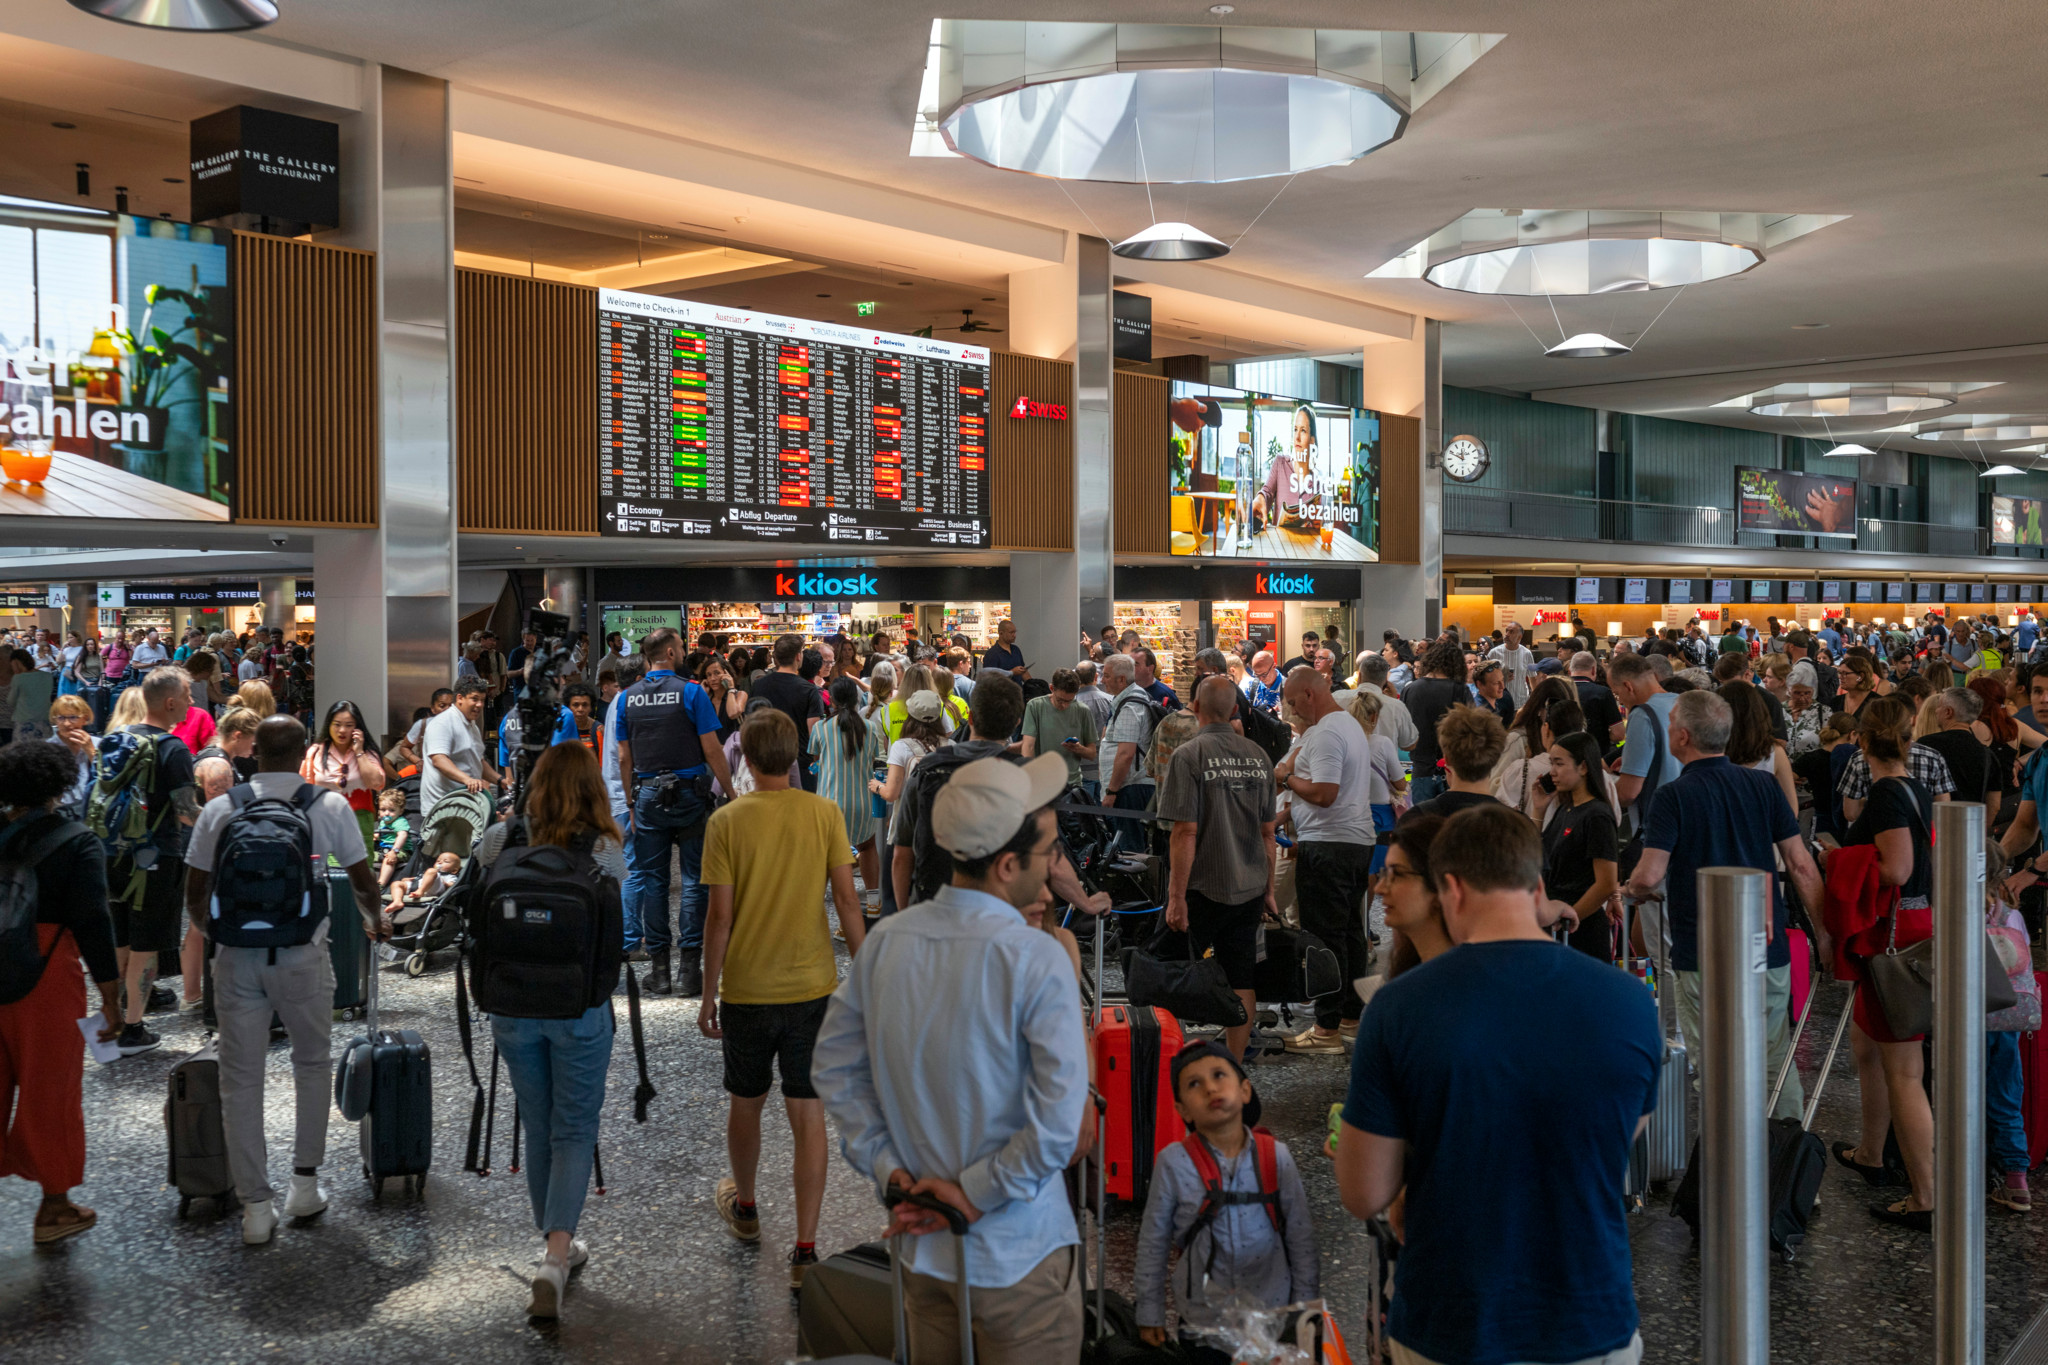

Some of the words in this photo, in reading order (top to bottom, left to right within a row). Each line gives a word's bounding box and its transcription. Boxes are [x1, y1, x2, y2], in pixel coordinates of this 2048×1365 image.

[191, 160, 206, 171] THE
[206, 150, 240, 167] GALLERY
[244, 150, 270, 162] THE
[277, 156, 336, 174] GALLERY
[198, 164, 232, 180] RESTAURANT
[258, 164, 322, 182] RESTAURANT
[606, 296, 642, 308] Welcome
[642, 302, 651, 310] to
[652, 302, 684, 315] Check-in
[715, 313, 742, 324] Austrian
[766, 320, 787, 329] brussels
[1126, 320, 1151, 330] GALLERY
[814, 327, 836, 338] CROATIA
[837, 331, 861, 342] AIRLINES
[1119, 326, 1145, 335] RESTAURANT
[880, 338, 906, 347] edelweiss
[926, 344, 950, 355] Lufthansa
[968, 352, 984, 360] SWISS
[1029, 401, 1067, 420] SWISS
[629, 507, 663, 516] Economy
[740, 510, 761, 521] Abflug
[764, 512, 798, 521] Departure
[1298, 498, 1358, 522] bezahlen
[839, 516, 857, 524] Gates
[799, 572, 878, 595] kiosk
[1269, 572, 1314, 594] kiosk
[618, 616, 667, 625] Irresistibly
[1543, 612, 1567, 623] SWISS
[1700, 611, 1720, 620] SWISS
[627, 691, 680, 708] POLIZEI
[1204, 769, 1267, 780] DAVIDSON
